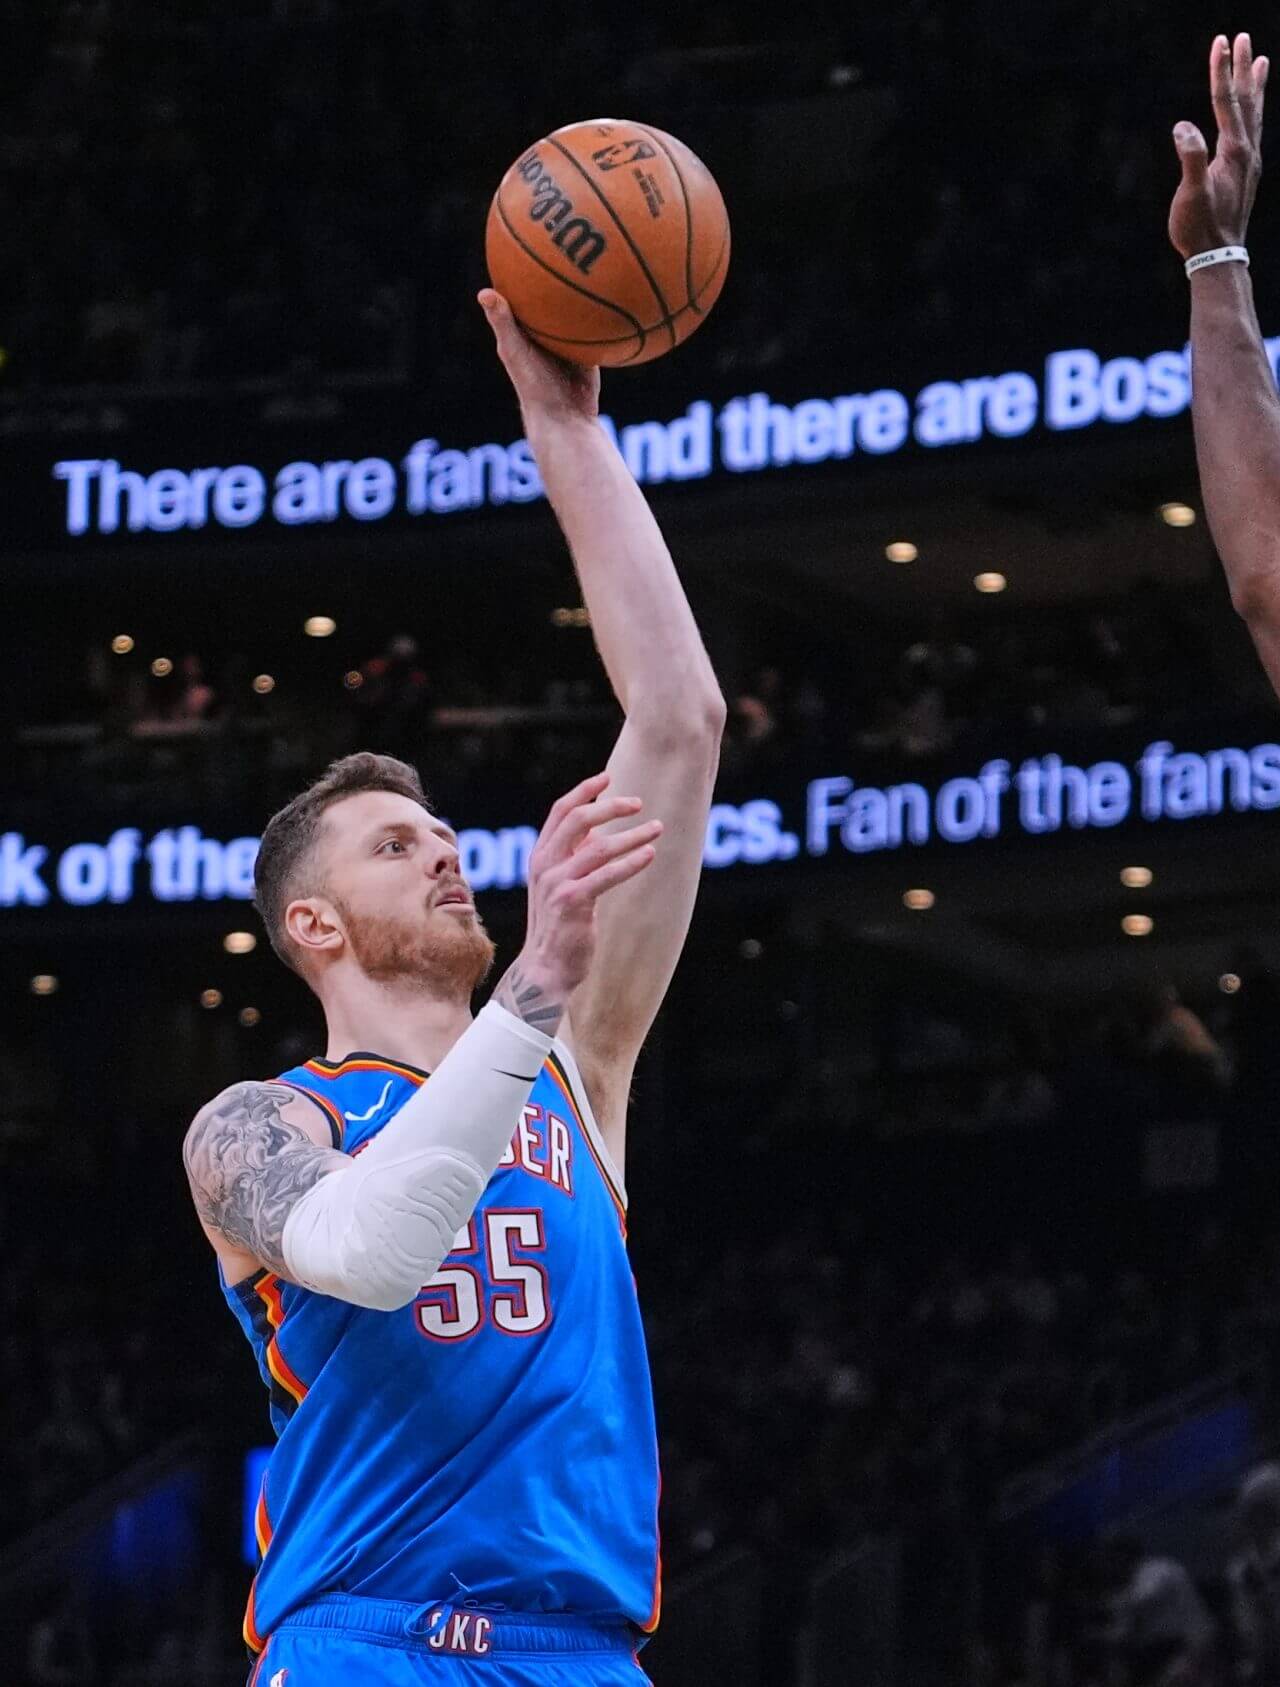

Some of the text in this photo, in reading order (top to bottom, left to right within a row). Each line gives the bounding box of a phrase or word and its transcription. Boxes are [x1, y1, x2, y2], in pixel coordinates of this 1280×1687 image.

[518, 150, 605, 275] Wilson
[55, 460, 266, 534] There
[273, 457, 396, 525] are
[717, 389, 909, 472] there
[914, 371, 1038, 446] are
[58, 828, 142, 905] of
[146, 825, 262, 902] the
[807, 777, 930, 855] Fan
[936, 759, 1011, 842] of
[1017, 753, 1131, 833] the
[414, 1208, 552, 1343] 55
